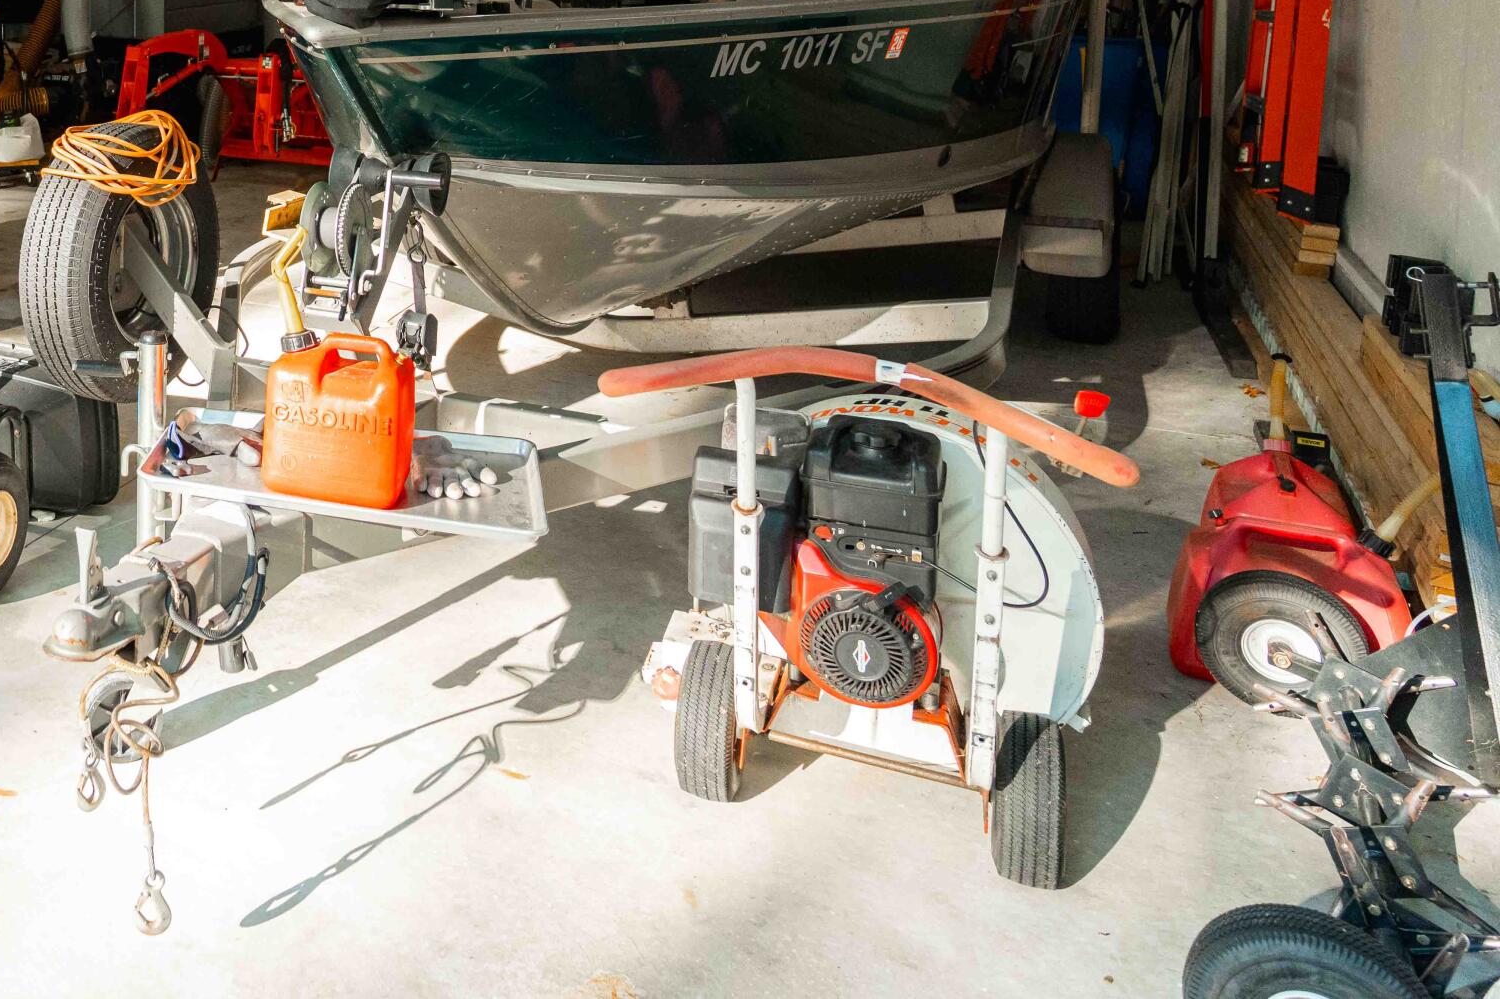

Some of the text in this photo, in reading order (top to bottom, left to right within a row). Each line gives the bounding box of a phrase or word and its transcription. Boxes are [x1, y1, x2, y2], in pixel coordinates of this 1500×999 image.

[890, 35, 905, 51] 26
[710, 29, 890, 78] MC 1011 SF
[853, 398, 908, 407] HP
[271, 401, 393, 436] GASOLINE
[811, 404, 916, 420] WOND
